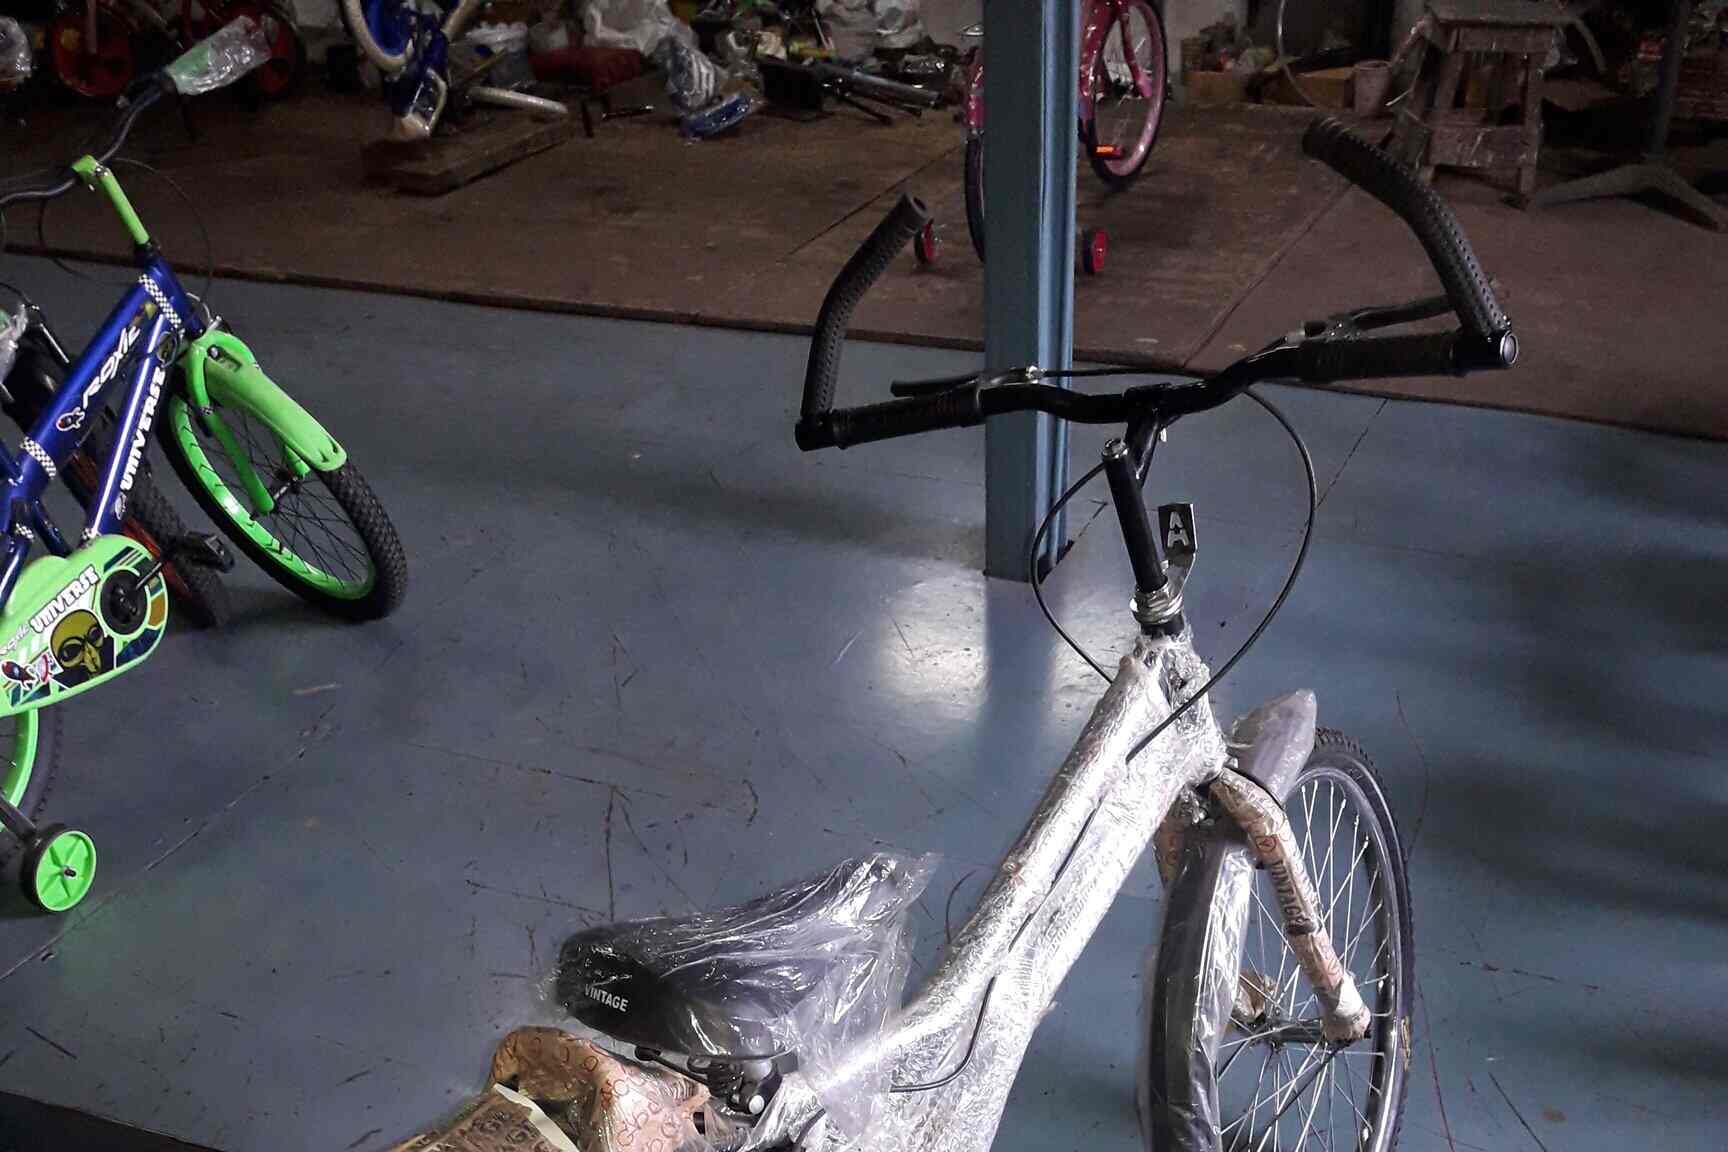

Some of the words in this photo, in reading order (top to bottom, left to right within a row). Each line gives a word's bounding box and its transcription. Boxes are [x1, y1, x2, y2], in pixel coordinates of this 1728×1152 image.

[120, 366, 166, 491] UNIVERSE
[1167, 511, 1190, 548] A
[30, 565, 100, 632] UNIVERSE
[584, 983, 629, 1013] VINTAGE
